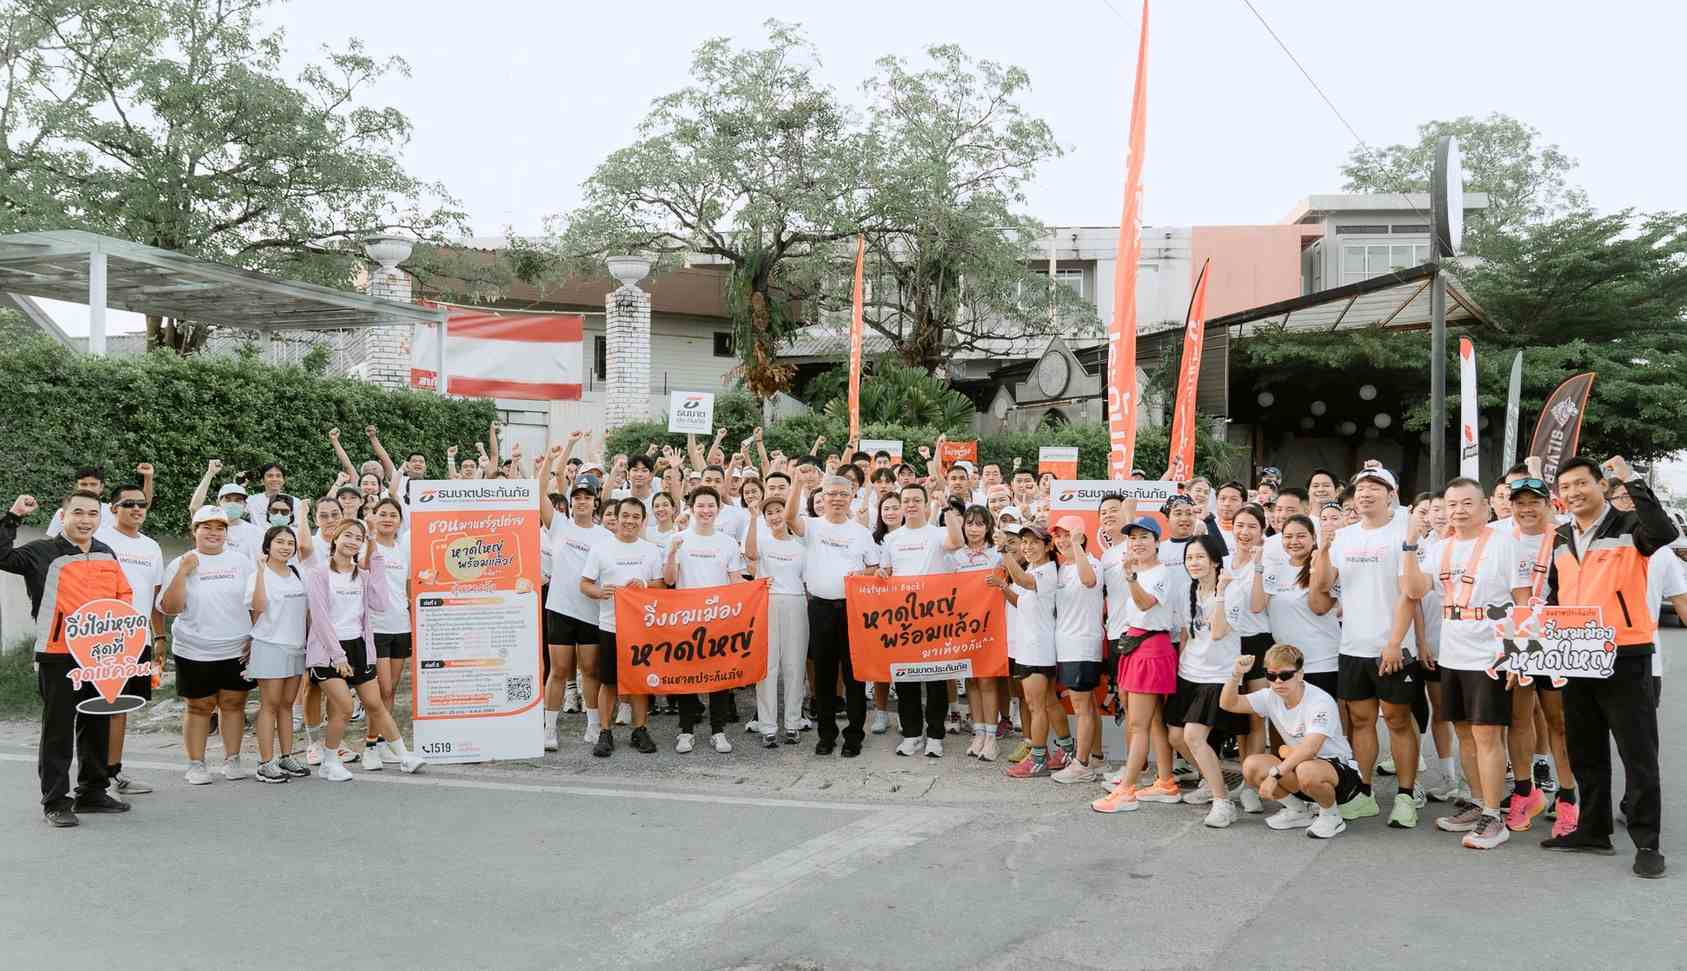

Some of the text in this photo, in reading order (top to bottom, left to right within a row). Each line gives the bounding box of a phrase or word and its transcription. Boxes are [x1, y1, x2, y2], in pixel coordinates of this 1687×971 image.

[644, 596, 743, 627] วิ่งชมเมือง
[863, 588, 957, 630] หาดใหญ่
[66, 610, 147, 638] วิ่งไม่หยุด
[880, 611, 991, 648] พร้อมแล้ว!
[1544, 619, 1613, 641] วิ่งชมเมือง
[91, 633, 124, 660] สุดที่
[630, 617, 755, 666] หาดใหญ่
[661, 667, 744, 686] ธนชาตประกันภัย
[430, 742, 452, 753] 1519
